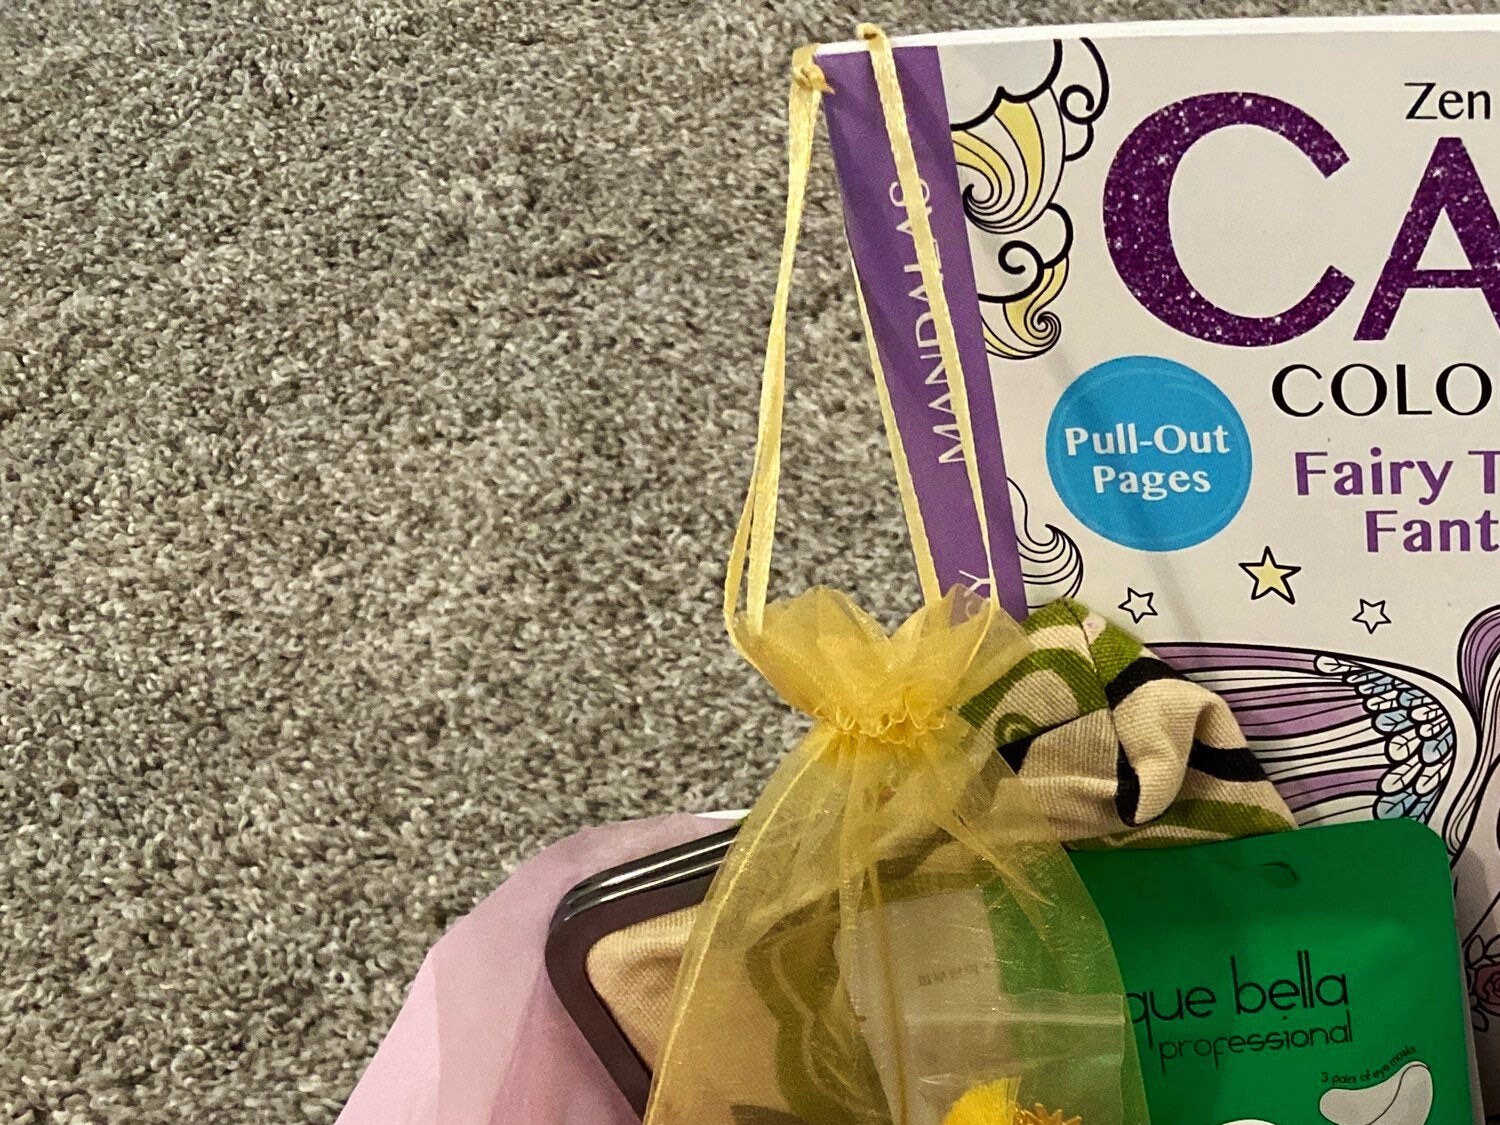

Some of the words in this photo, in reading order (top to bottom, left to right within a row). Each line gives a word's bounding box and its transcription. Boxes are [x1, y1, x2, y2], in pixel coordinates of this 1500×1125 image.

[1404, 82, 1493, 121] Zen
[1064, 424, 1230, 456] Pull-Out
[1093, 466, 1212, 500] Pages
[1293, 446, 1454, 500] Fairy
[1126, 985, 1216, 1049] que
[1230, 950, 1350, 1016] bella
[1159, 1010, 1354, 1075] professional
